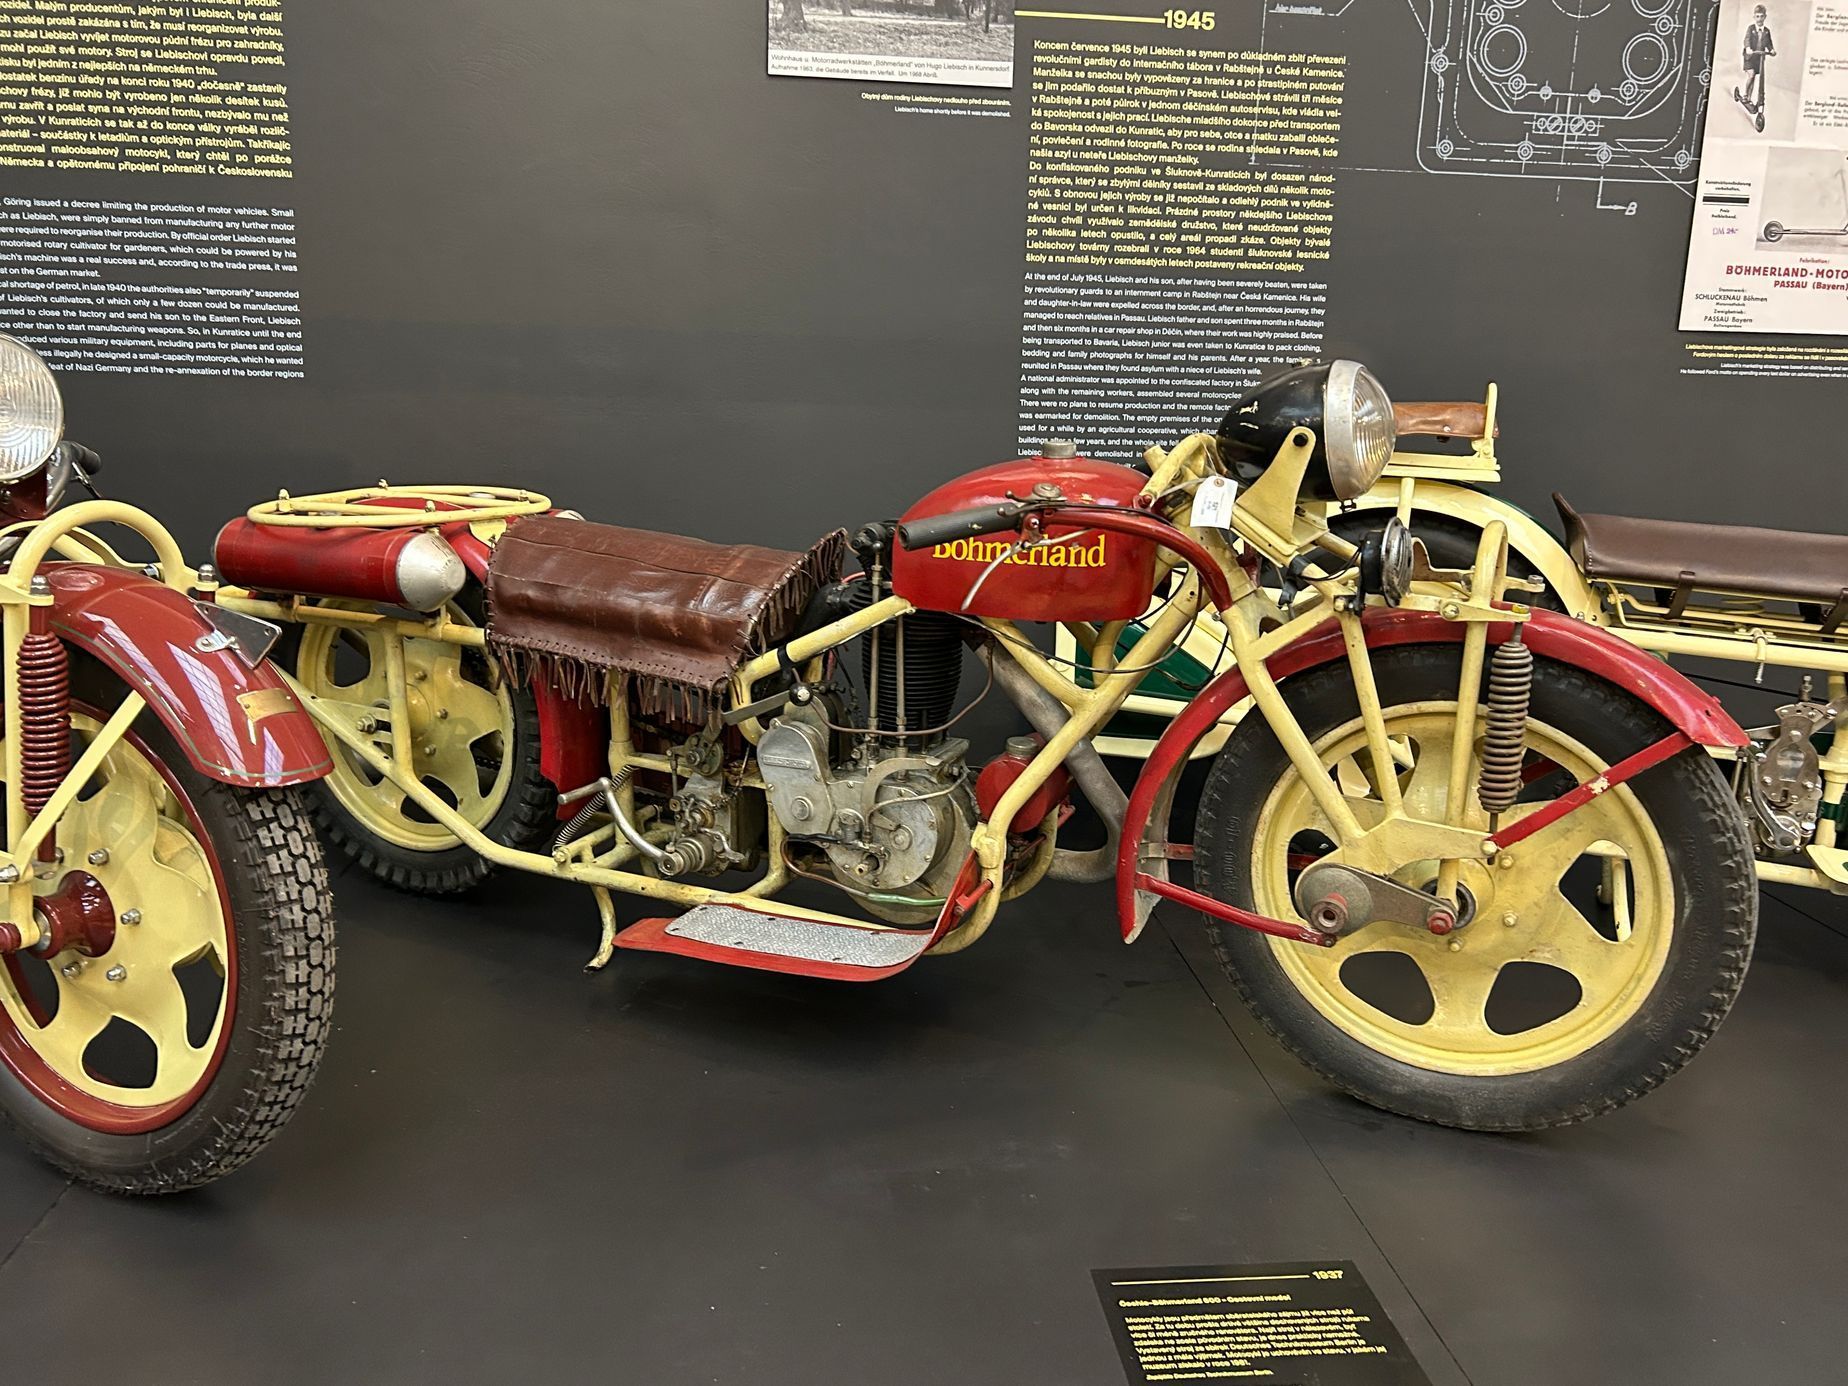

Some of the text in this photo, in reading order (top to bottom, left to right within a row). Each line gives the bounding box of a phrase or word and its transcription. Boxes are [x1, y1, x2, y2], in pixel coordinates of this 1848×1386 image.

[1164, 9, 1215, 30] 1945
[0, 42, 24, 51] mohl
[78, 46, 112, 57] motory.
[115, 47, 137, 59] Stroj
[155, 49, 207, 60] Liebischovi
[210, 52, 248, 64] opravdu
[250, 54, 285, 66] povedl,
[1034, 40, 1068, 50] Koncem
[1111, 44, 1131, 53] 1945
[1133, 45, 1147, 55] byli
[1149, 46, 1184, 56] Liebisch
[1198, 50, 1225, 59] synem
[1227, 52, 1238, 60] po
[208, 165, 215, 174] k
[33, 198, 60, 207] issued
[70, 200, 99, 208] decree
[102, 201, 131, 211] limiting
[134, 202, 147, 210] the
[150, 203, 194, 214] production
[196, 205, 204, 213] of
[207, 205, 231, 214] motor
[233, 207, 269, 216] vehicles.
[271, 208, 294, 217] Small
[1302, 225, 1331, 235] objekty
[0, 238, 41, 247] motorised
[43, 240, 67, 250] rotary
[70, 241, 107, 250] cultivator
[109, 243, 120, 251] for
[123, 243, 167, 254] gardeners,
[169, 245, 193, 253] which
[195, 246, 218, 254] could
[221, 247, 232, 255] be
[234, 248, 269, 258] powered
[272, 249, 281, 258] by
[1026, 240, 1075, 251] Liebischovy
[1113, 243, 1149, 252] rozebrali
[1186, 246, 1205, 254] 1964
[1210, 247, 1243, 256] studenti
[1070, 274, 1084, 282] July
[1104, 275, 1133, 283] Liebisch
[1193, 278, 1215, 287] having
[1235, 280, 1263, 288] severely
[1264, 281, 1289, 289] beaten,
[1774, 280, 1808, 289] PASSAU
[1024, 285, 1032, 294] by
[1034, 286, 1078, 295] revolutionary
[1079, 287, 1103, 296] guards
[1162, 291, 1182, 299] camp
[1263, 293, 1297, 301] Kamenice.
[7, 293, 47, 302] Liebisch's
[49, 295, 93, 305] cultivators,
[106, 297, 130, 305] which
[133, 298, 149, 307] only
[160, 299, 175, 307] few
[177, 300, 202, 308] dozen
[204, 301, 227, 309] could
[243, 302, 300, 311] manufactured.
[1311, 1270, 1344, 1280] 1937
[1264, 1294, 1292, 1302] model
